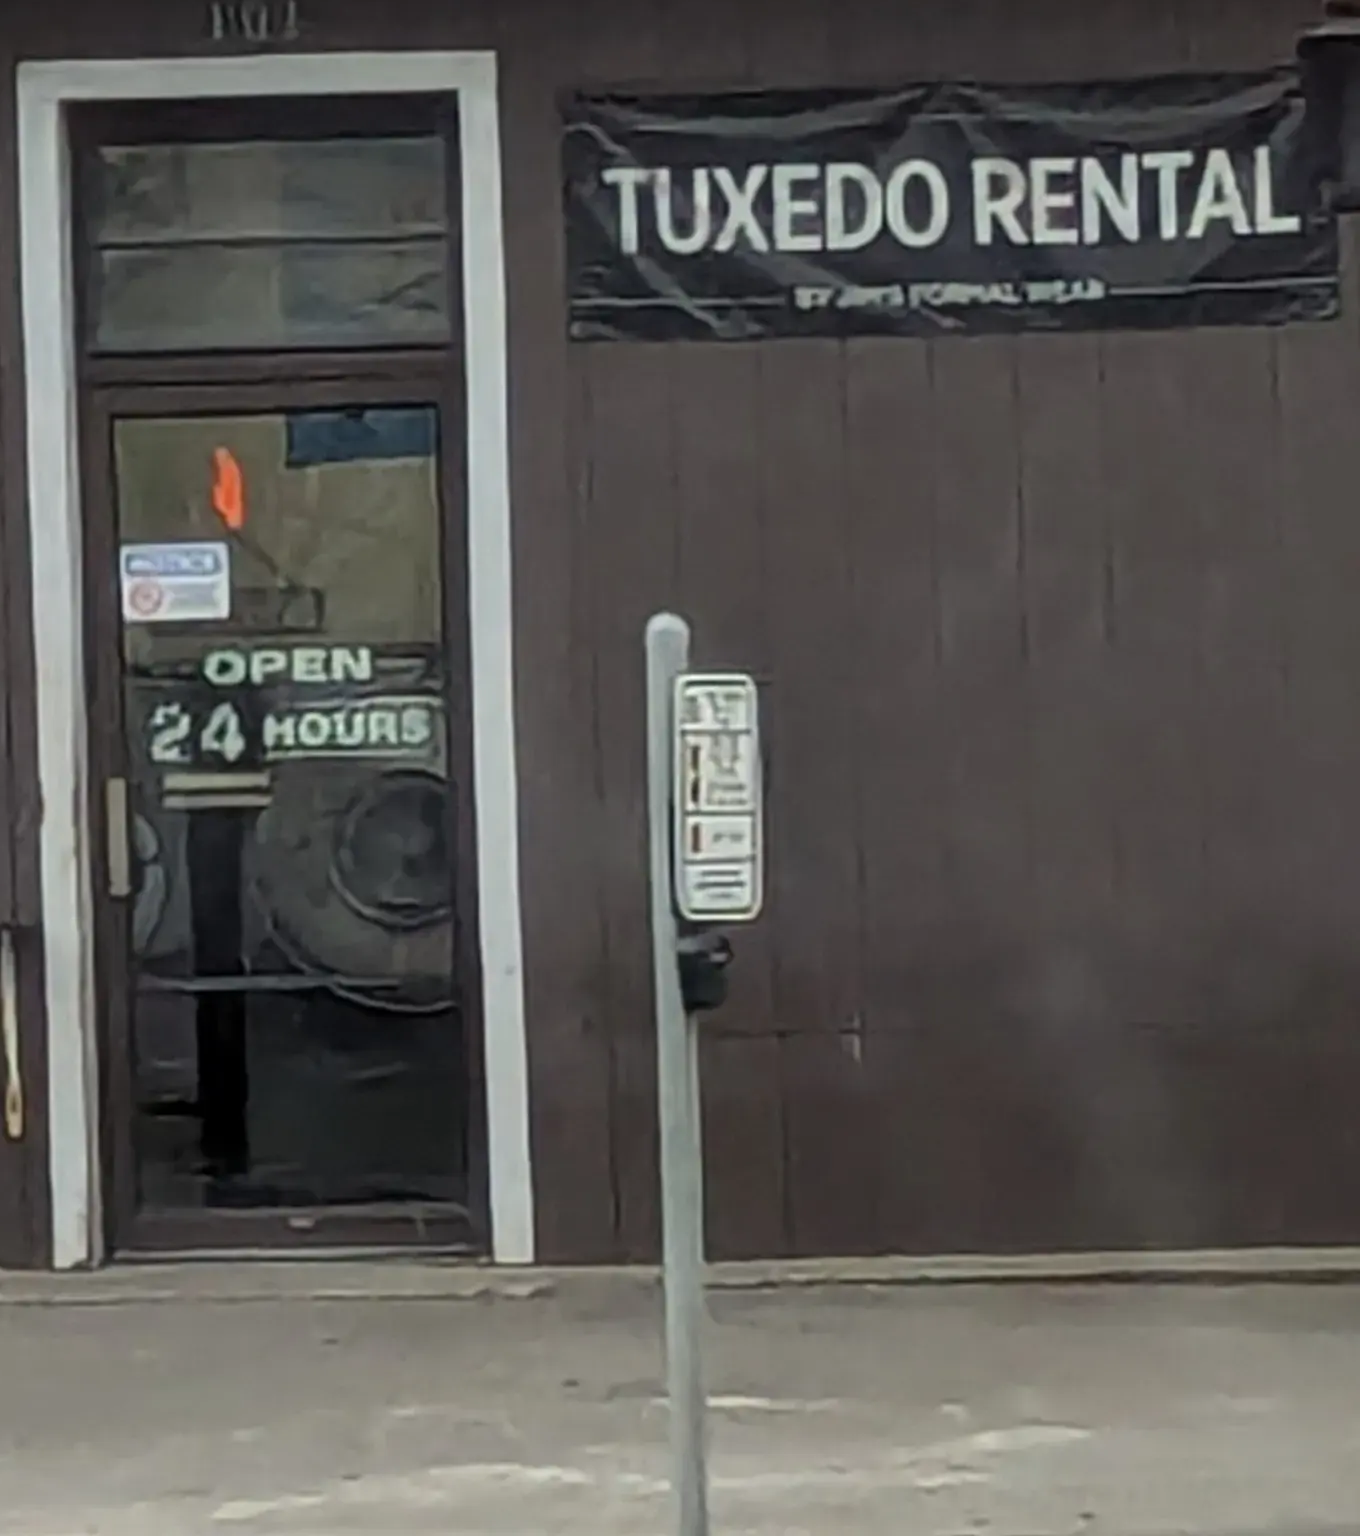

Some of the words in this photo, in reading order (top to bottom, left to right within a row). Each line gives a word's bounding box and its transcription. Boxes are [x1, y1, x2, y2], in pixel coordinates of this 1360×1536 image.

[602, 158, 950, 256] TUXEDO
[970, 145, 1302, 247] RENTAL
[204, 646, 373, 685] OPEN
[149, 702, 246, 763] 24
[263, 708, 432, 748] HOURS
